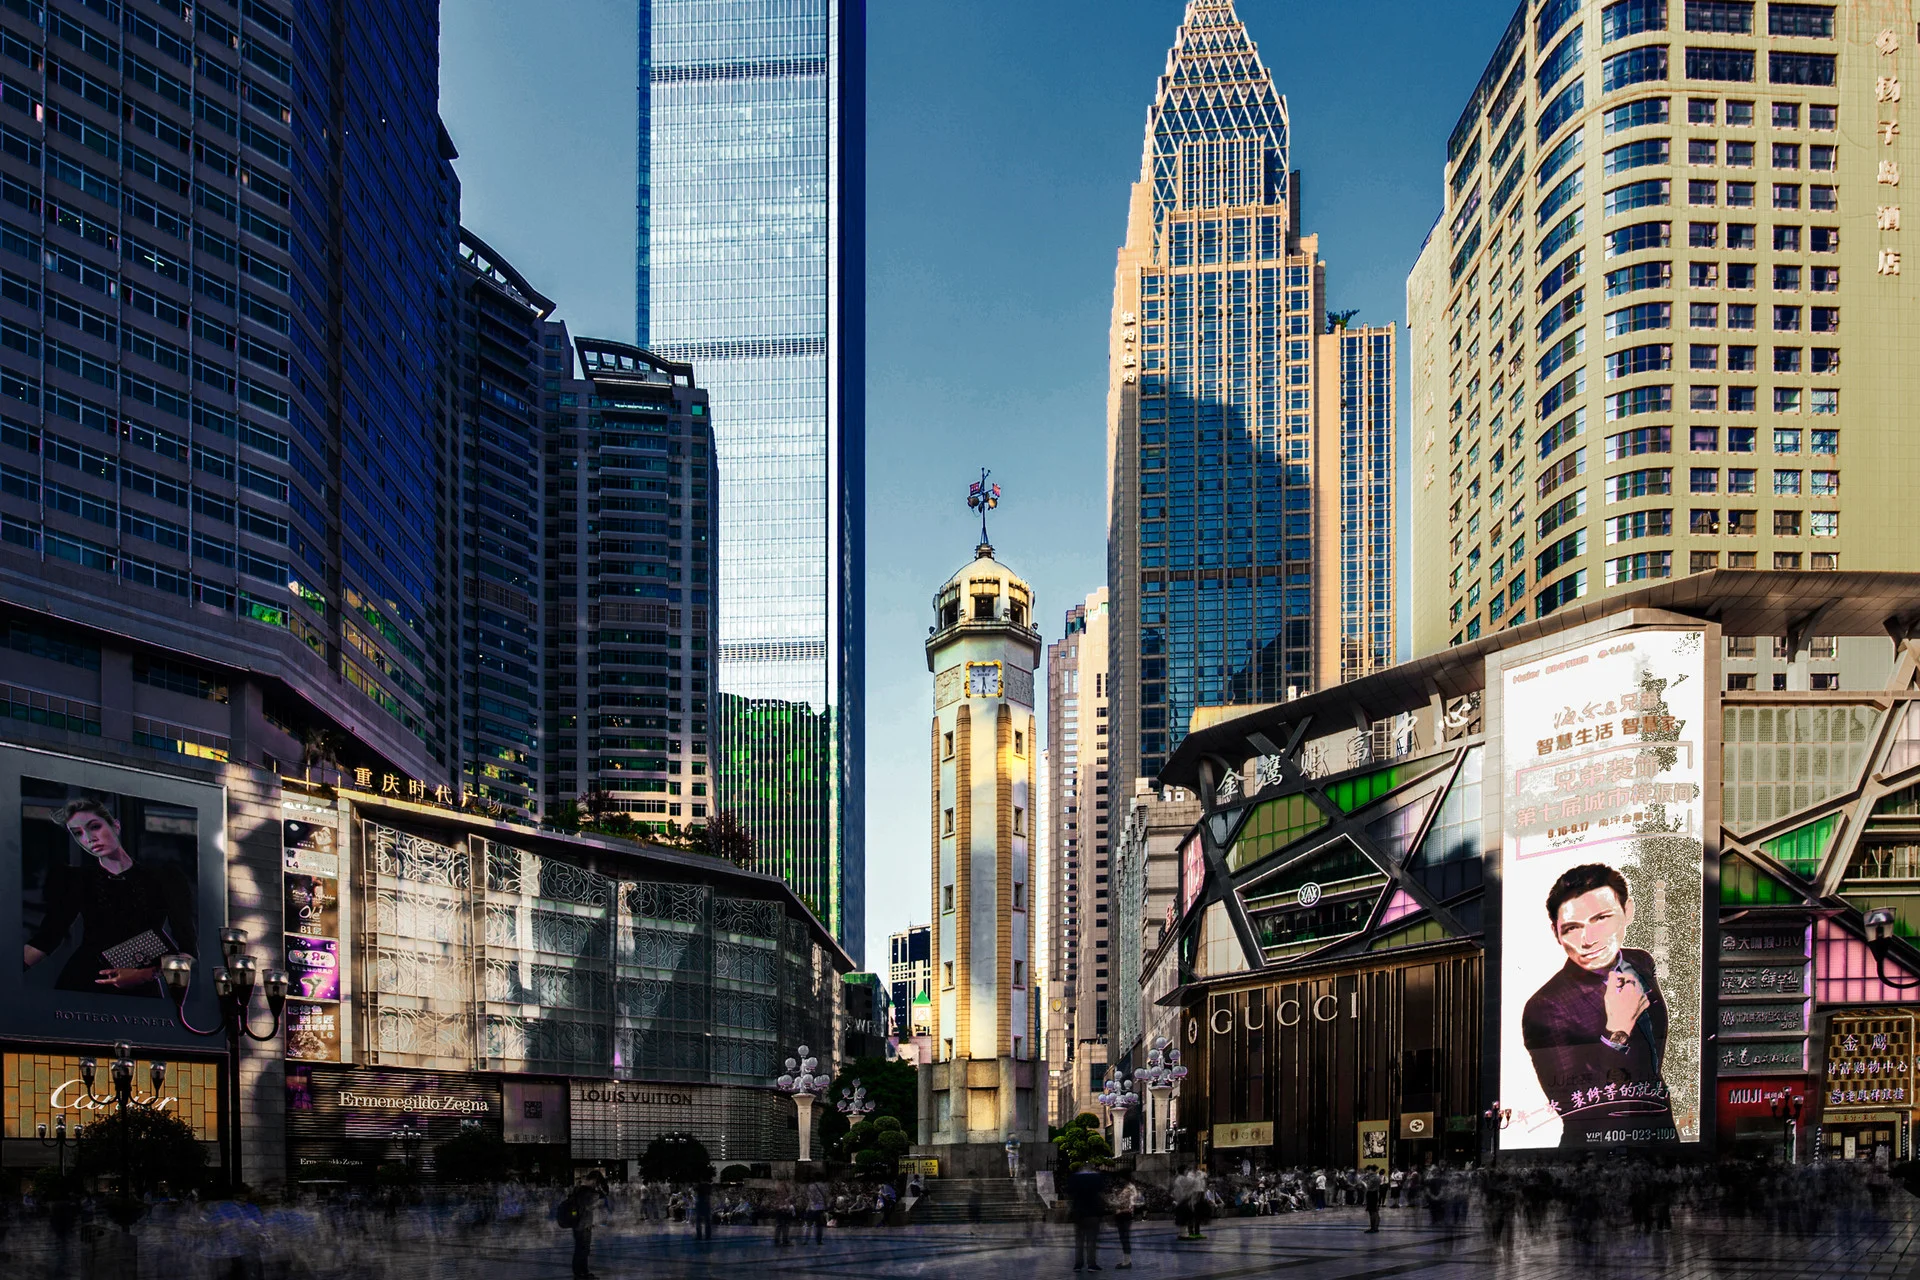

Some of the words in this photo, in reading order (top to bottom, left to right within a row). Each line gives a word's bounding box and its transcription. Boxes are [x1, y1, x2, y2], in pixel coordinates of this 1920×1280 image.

[1536, 722, 1614, 756] 智慧生活
[1621, 715, 1676, 735] 智慧家
[1554, 755, 1660, 796] 兄弟装饰
[354, 767, 502, 815] 重庆时代广场
[1516, 782, 1695, 829] 第七届城市样板间
[1547, 822, 1589, 838] 9.16-9.17
[286, 859, 299, 869] L4
[326, 943, 336, 951] L5
[55, 1010, 119, 1024] BOTTEGA
[122, 1014, 176, 1028] VENETA
[1210, 992, 1358, 1035] GUCCI
[337, 1091, 440, 1112] Ermenegildo
[443, 1096, 489, 1114] Zegna
[581, 1089, 626, 1103] LOUIS
[631, 1091, 693, 1105] VUITTON
[1729, 1088, 1762, 1104] MUJI
[1604, 1128, 1676, 1142] 400-023-1100
